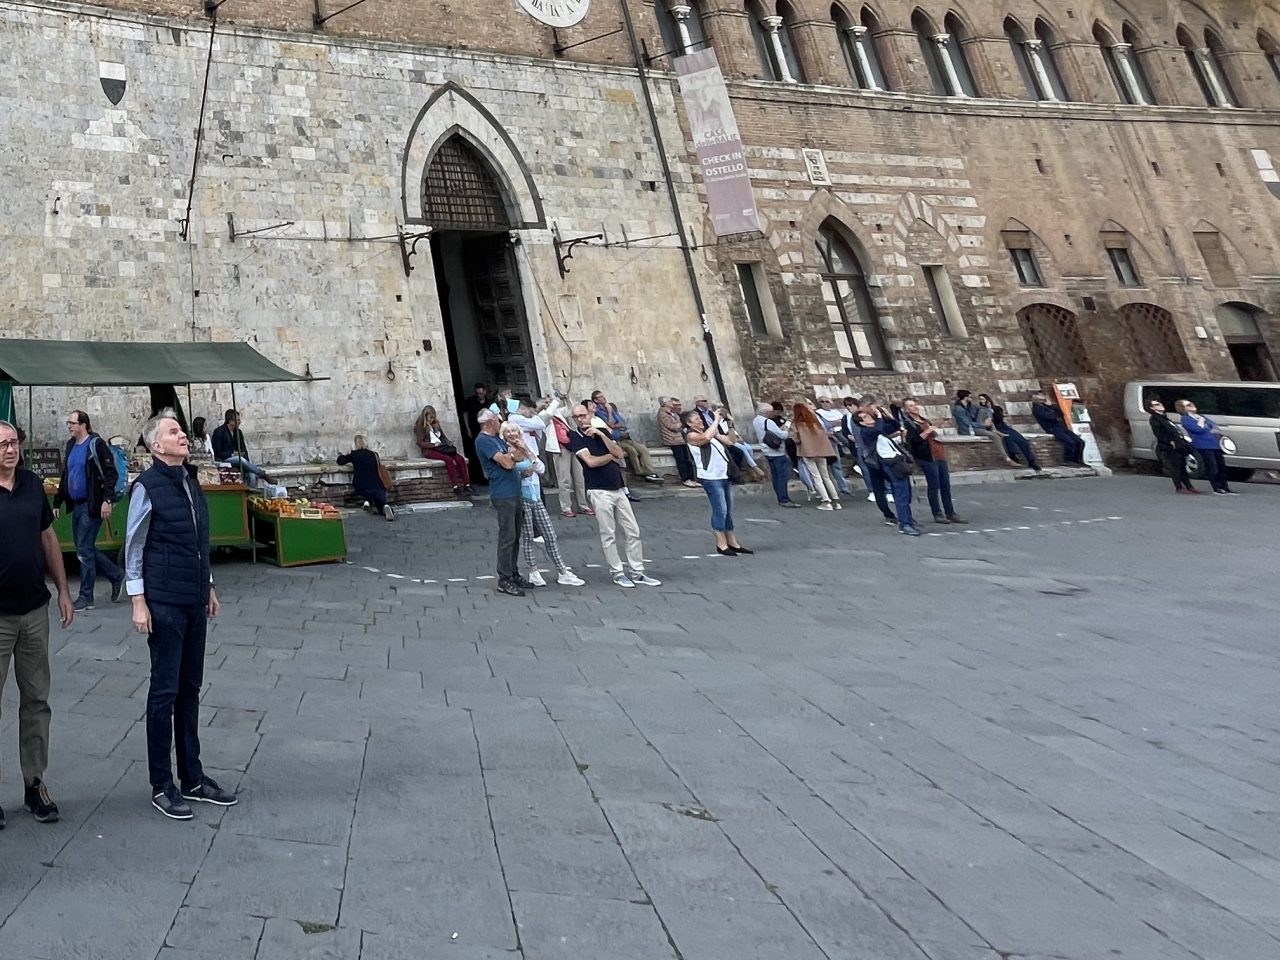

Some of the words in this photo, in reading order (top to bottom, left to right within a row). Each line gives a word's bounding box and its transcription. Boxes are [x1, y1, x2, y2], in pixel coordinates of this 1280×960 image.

[704, 128, 728, 138] CASA
[702, 154, 731, 165] CHECK
[731, 152, 742, 161] IN
[705, 163, 744, 176] OSTELLO
